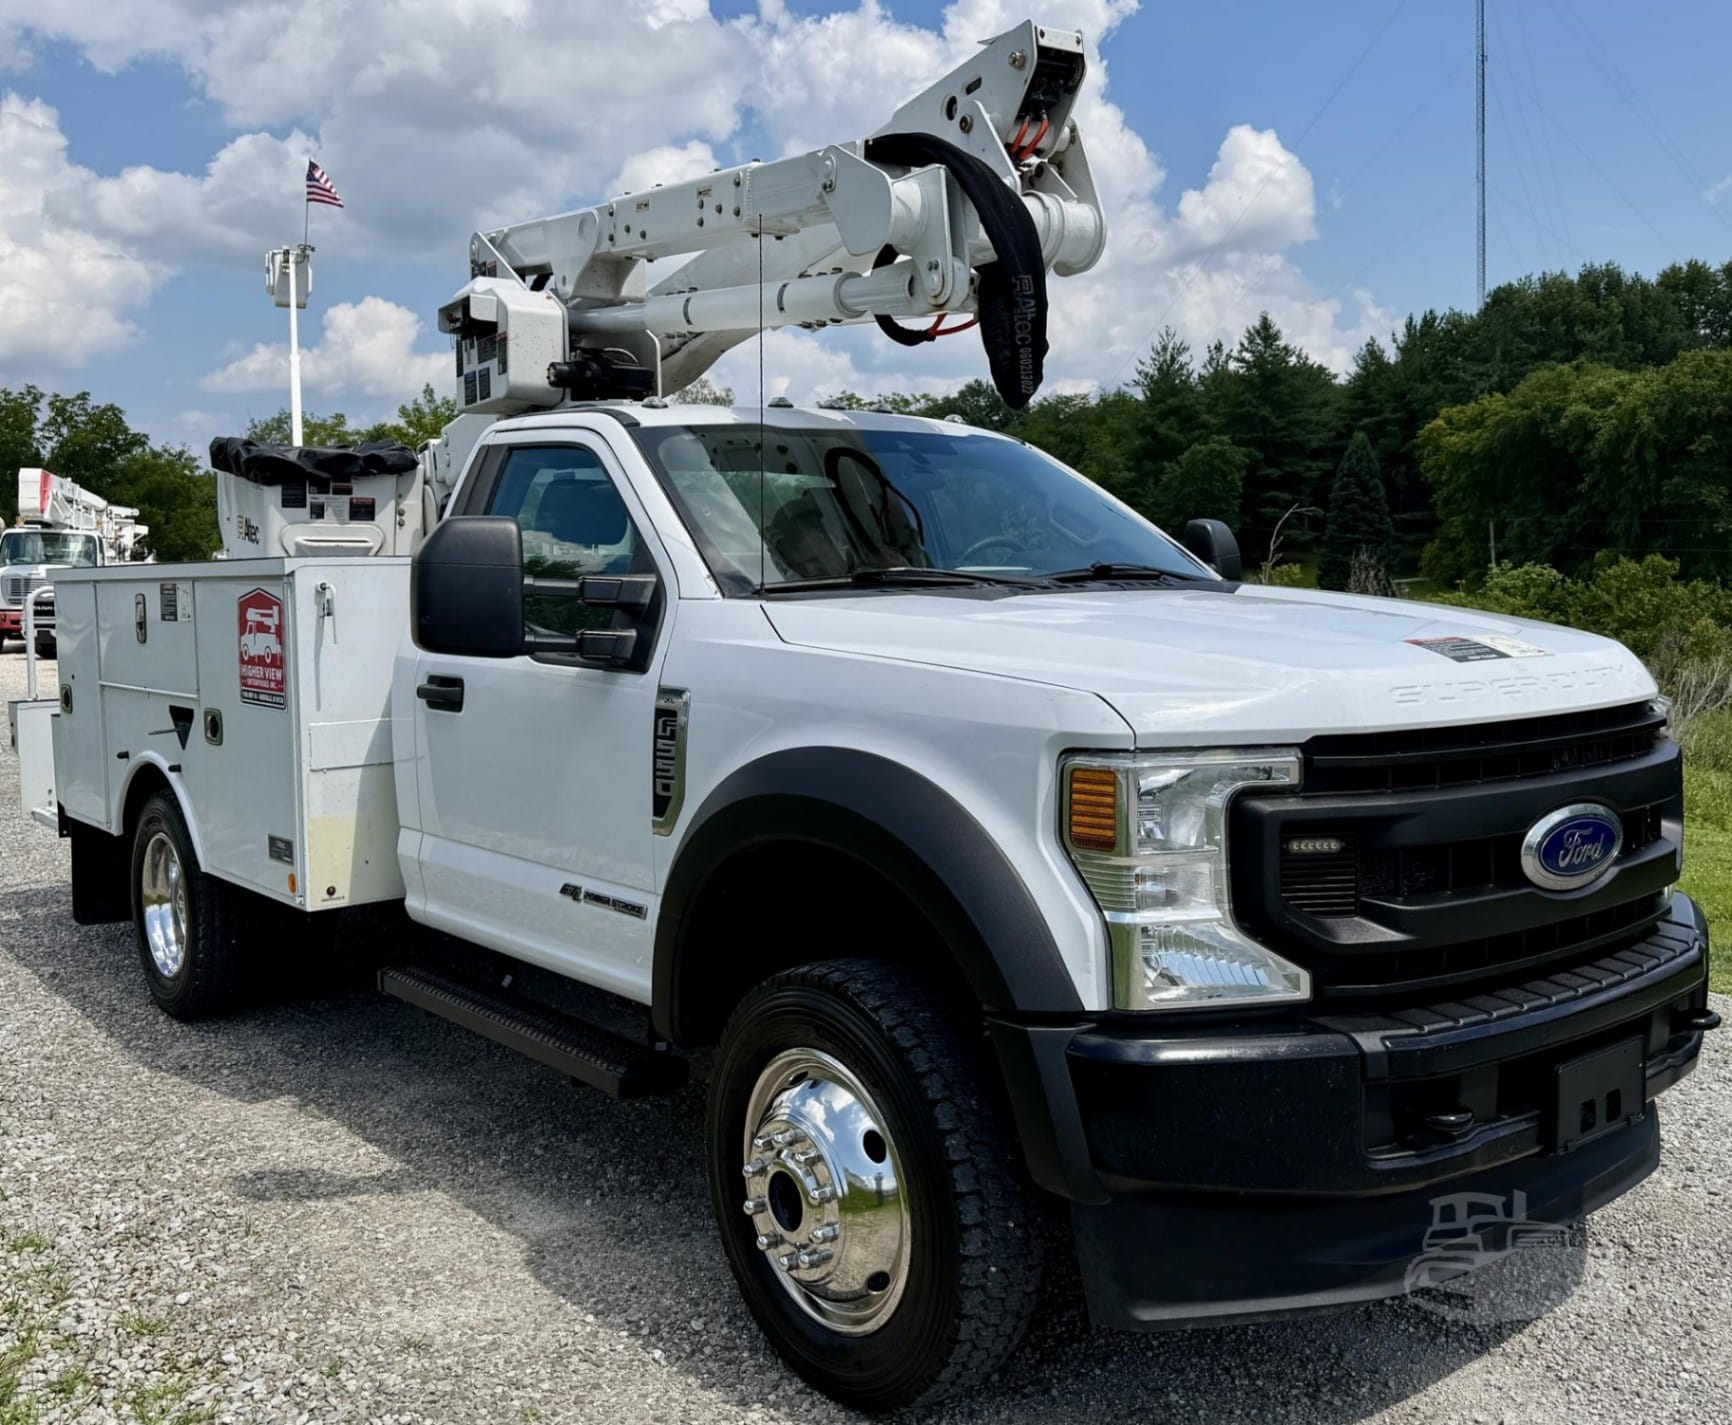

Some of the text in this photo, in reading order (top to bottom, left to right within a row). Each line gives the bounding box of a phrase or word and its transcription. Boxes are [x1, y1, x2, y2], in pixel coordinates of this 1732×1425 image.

[1013, 297, 1037, 345] Altec
[241, 664, 283, 681] HIGHER VIEW
[1558, 827, 1605, 867] Ford
